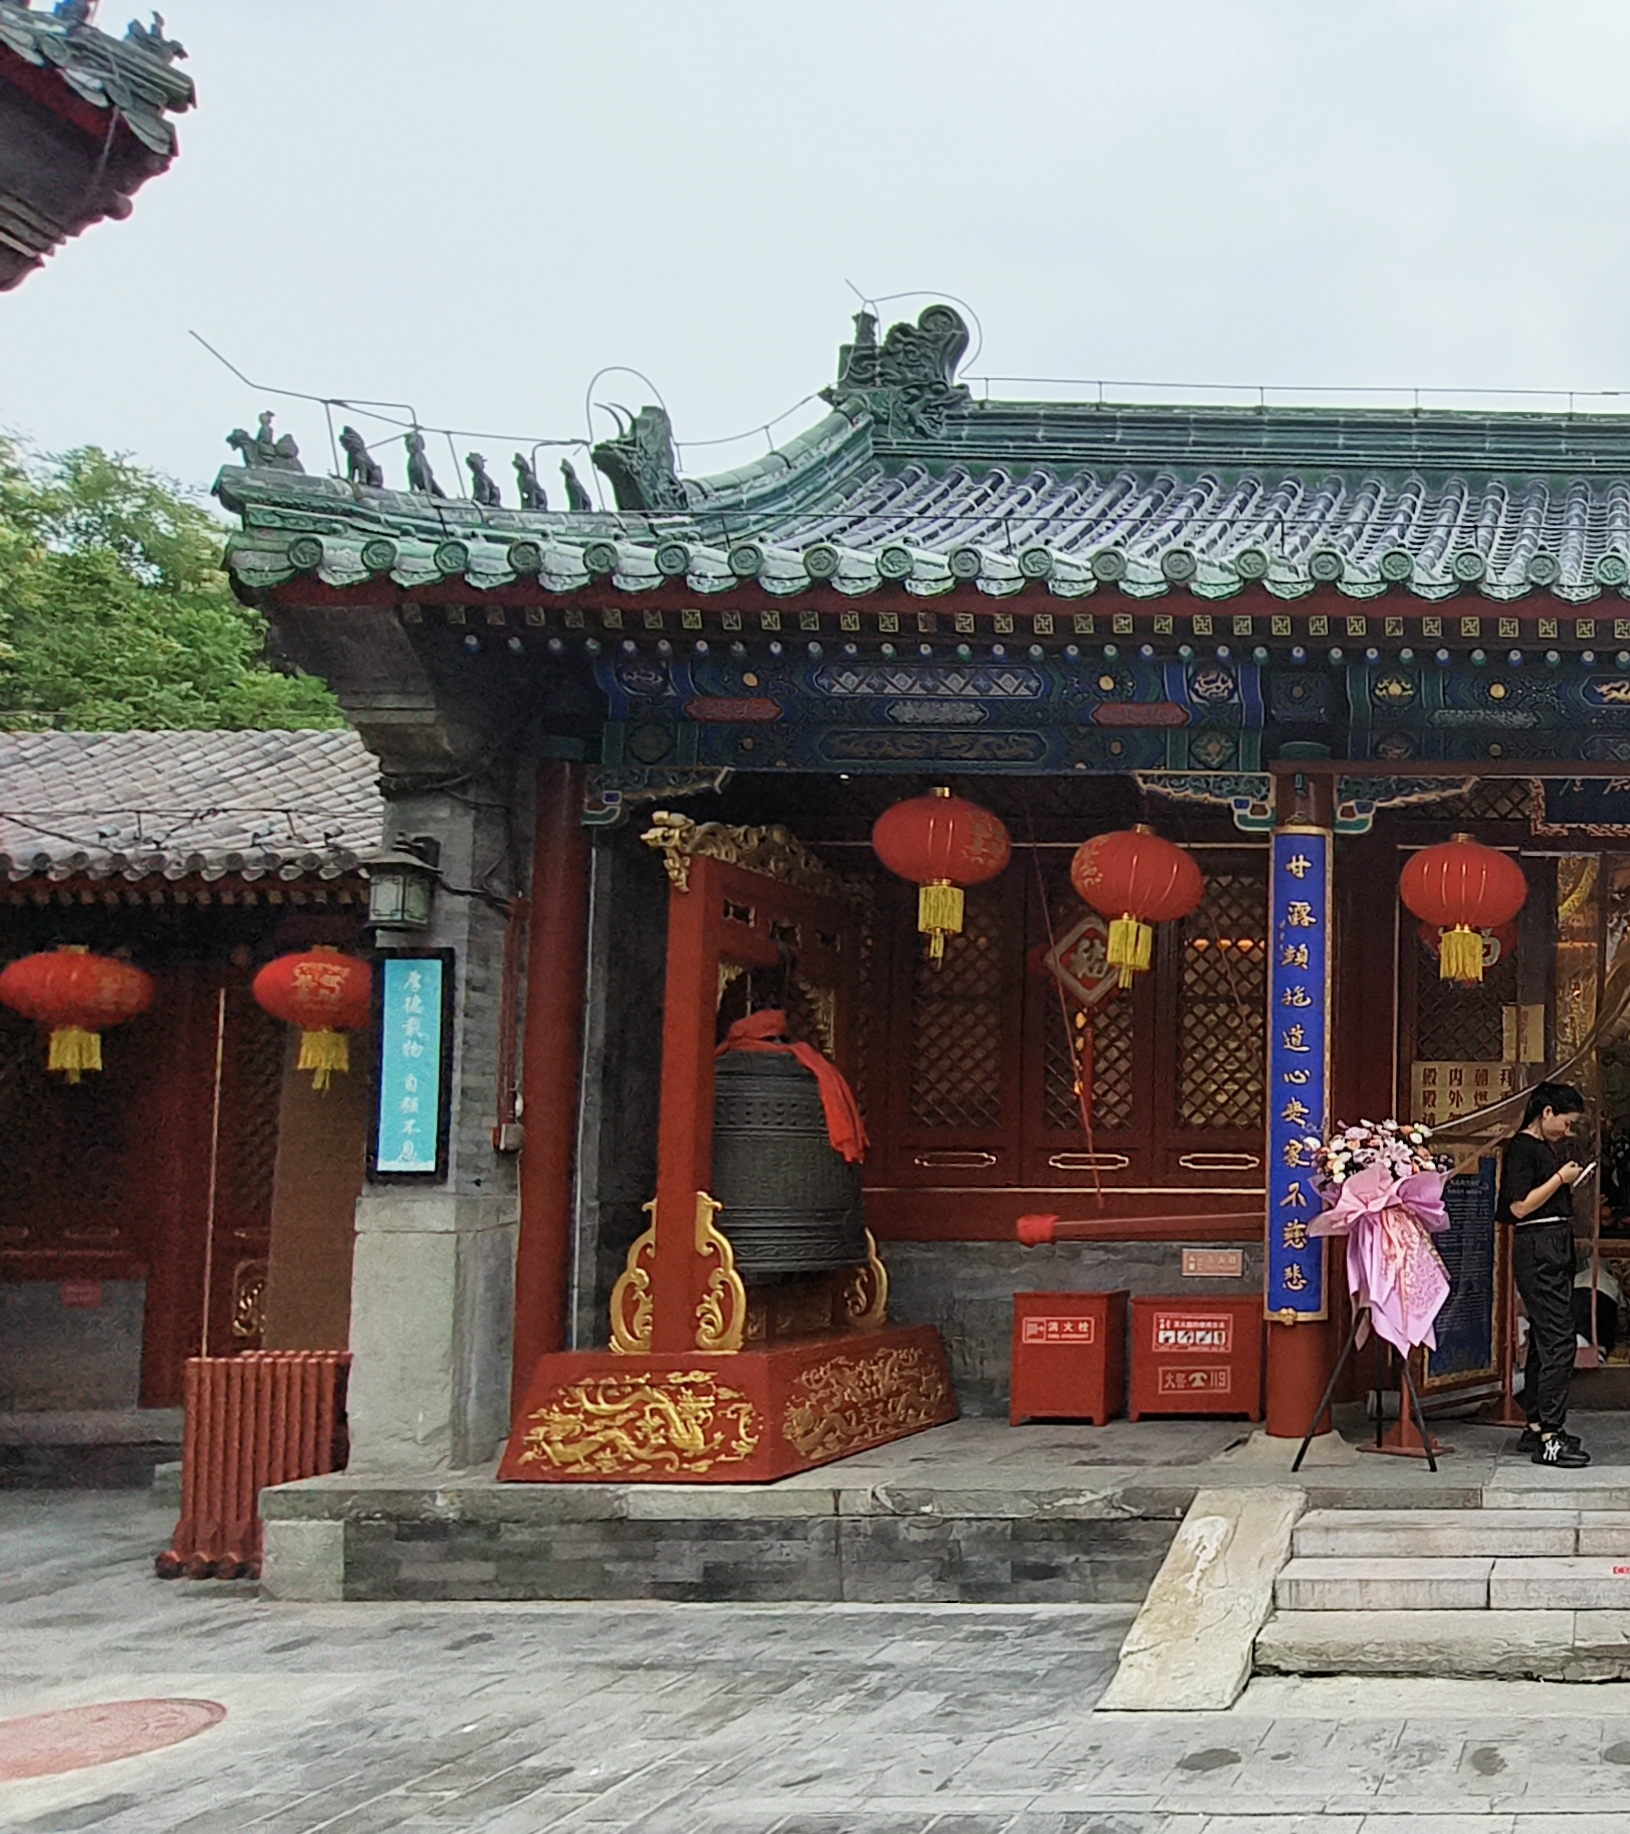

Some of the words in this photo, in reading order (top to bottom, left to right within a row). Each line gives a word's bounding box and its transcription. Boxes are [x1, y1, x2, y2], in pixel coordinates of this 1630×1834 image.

[1047, 1321, 1090, 1332] 消火栓
[1163, 1373, 1188, 1389] 火警
[1210, 1371, 1226, 1387] 119
